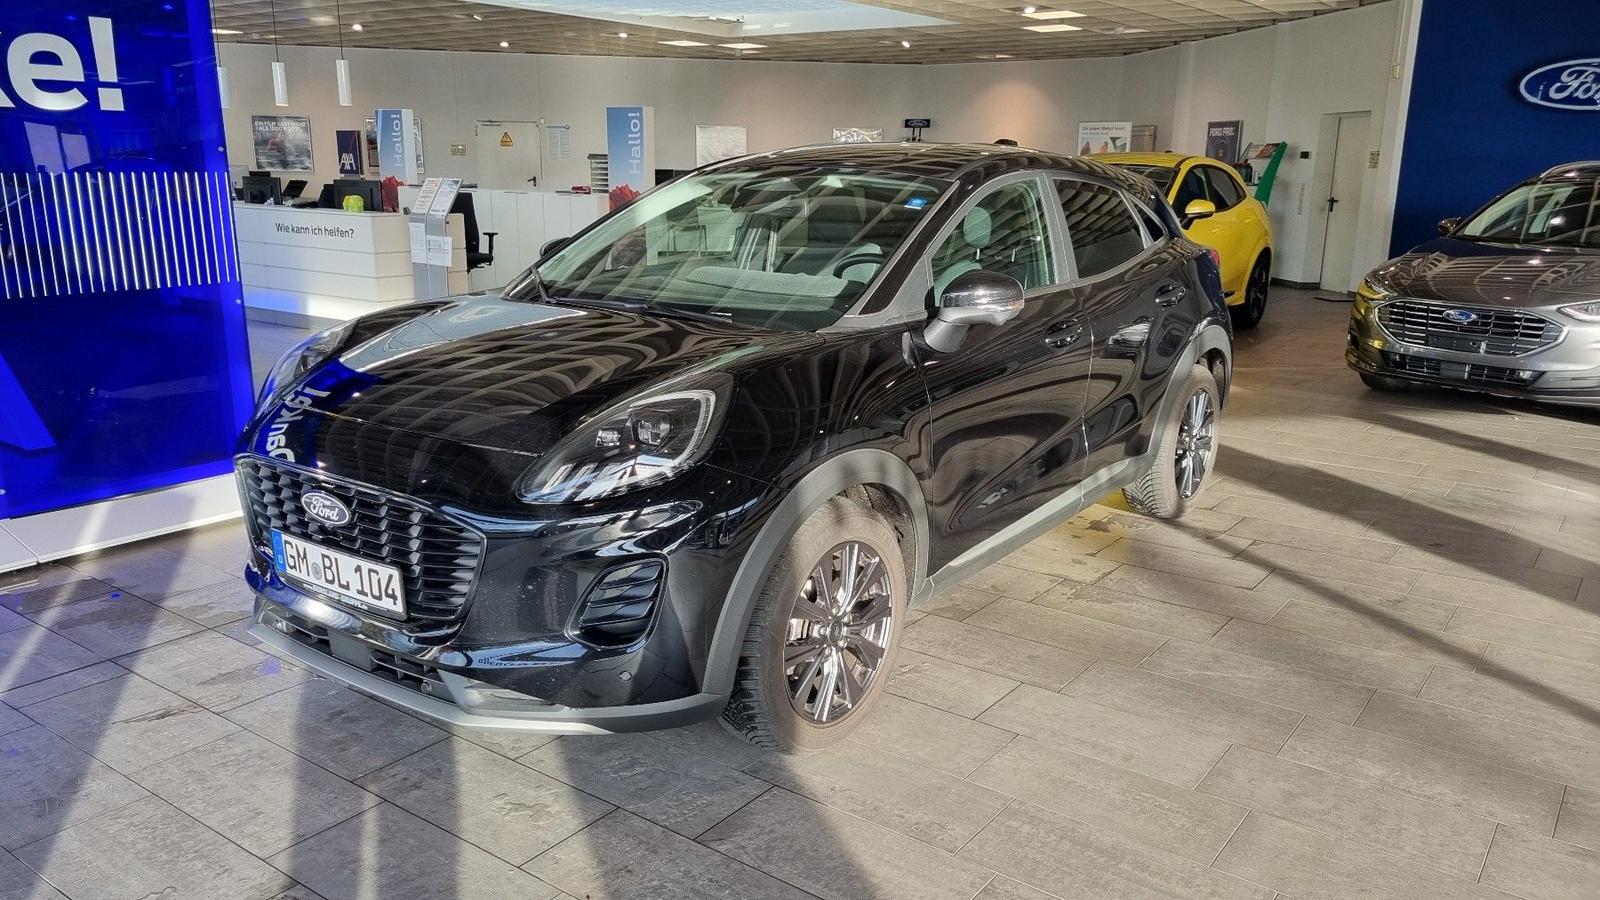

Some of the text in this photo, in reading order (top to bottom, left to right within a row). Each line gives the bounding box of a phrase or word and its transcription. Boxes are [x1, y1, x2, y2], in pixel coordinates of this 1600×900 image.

[0, 16, 125, 111] e!
[1549, 66, 1600, 103] Fo
[340, 153, 356, 170] AXA
[390, 113, 404, 168] Hallo!
[628, 111, 641, 175] Hallo!
[275, 222, 355, 239] Wie kann ich helfen?
[310, 496, 339, 520] Ford
[284, 539, 310, 577] GM
[321, 552, 350, 592] BL
[354, 563, 398, 606] 104
